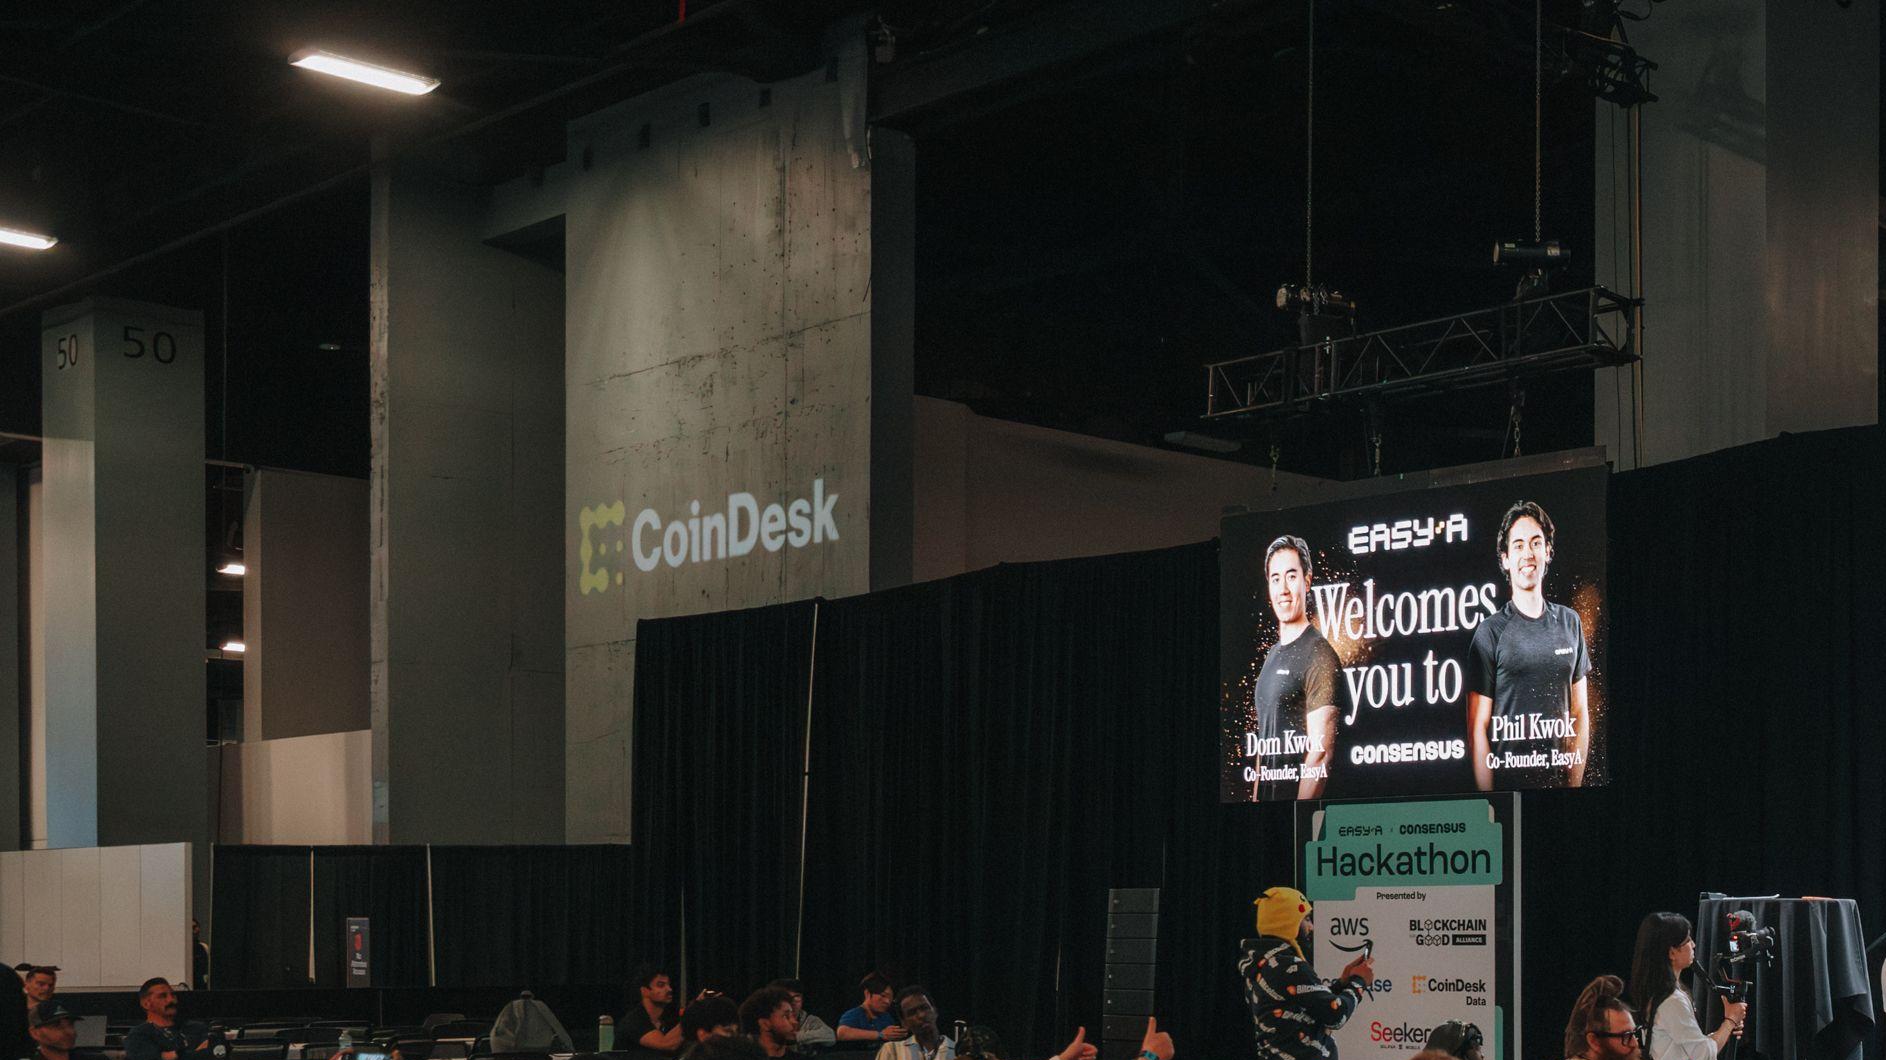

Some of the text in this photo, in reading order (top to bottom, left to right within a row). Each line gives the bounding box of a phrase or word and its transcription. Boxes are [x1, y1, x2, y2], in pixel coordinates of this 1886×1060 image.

[57, 333, 79, 371] 50
[123, 325, 177, 365] 50
[631, 477, 841, 573] CoinDesk
[1311, 577, 1498, 642] Welcomes
[1343, 650, 1464, 727] you to
[1491, 711, 1578, 742] Phil Kwok
[1245, 729, 1326, 758] Dom Kwok
[1349, 738, 1466, 766] CONSENSUS
[1485, 748, 1583, 769] Co-Founder, EasyA
[1243, 762, 1328, 783] Co-Founder, EasyA
[1399, 822, 1467, 835] CONSENSUS
[1316, 842, 1491, 877] Hackathon
[1376, 891, 1427, 902] Presented by
[1329, 916, 1370, 937] aws
[1455, 936, 1483, 944] ALLIANCE
[1428, 977, 1487, 993] CoinDesk
[1465, 996, 1487, 1007] Data
[1370, 1021, 1432, 1043] Seeker
